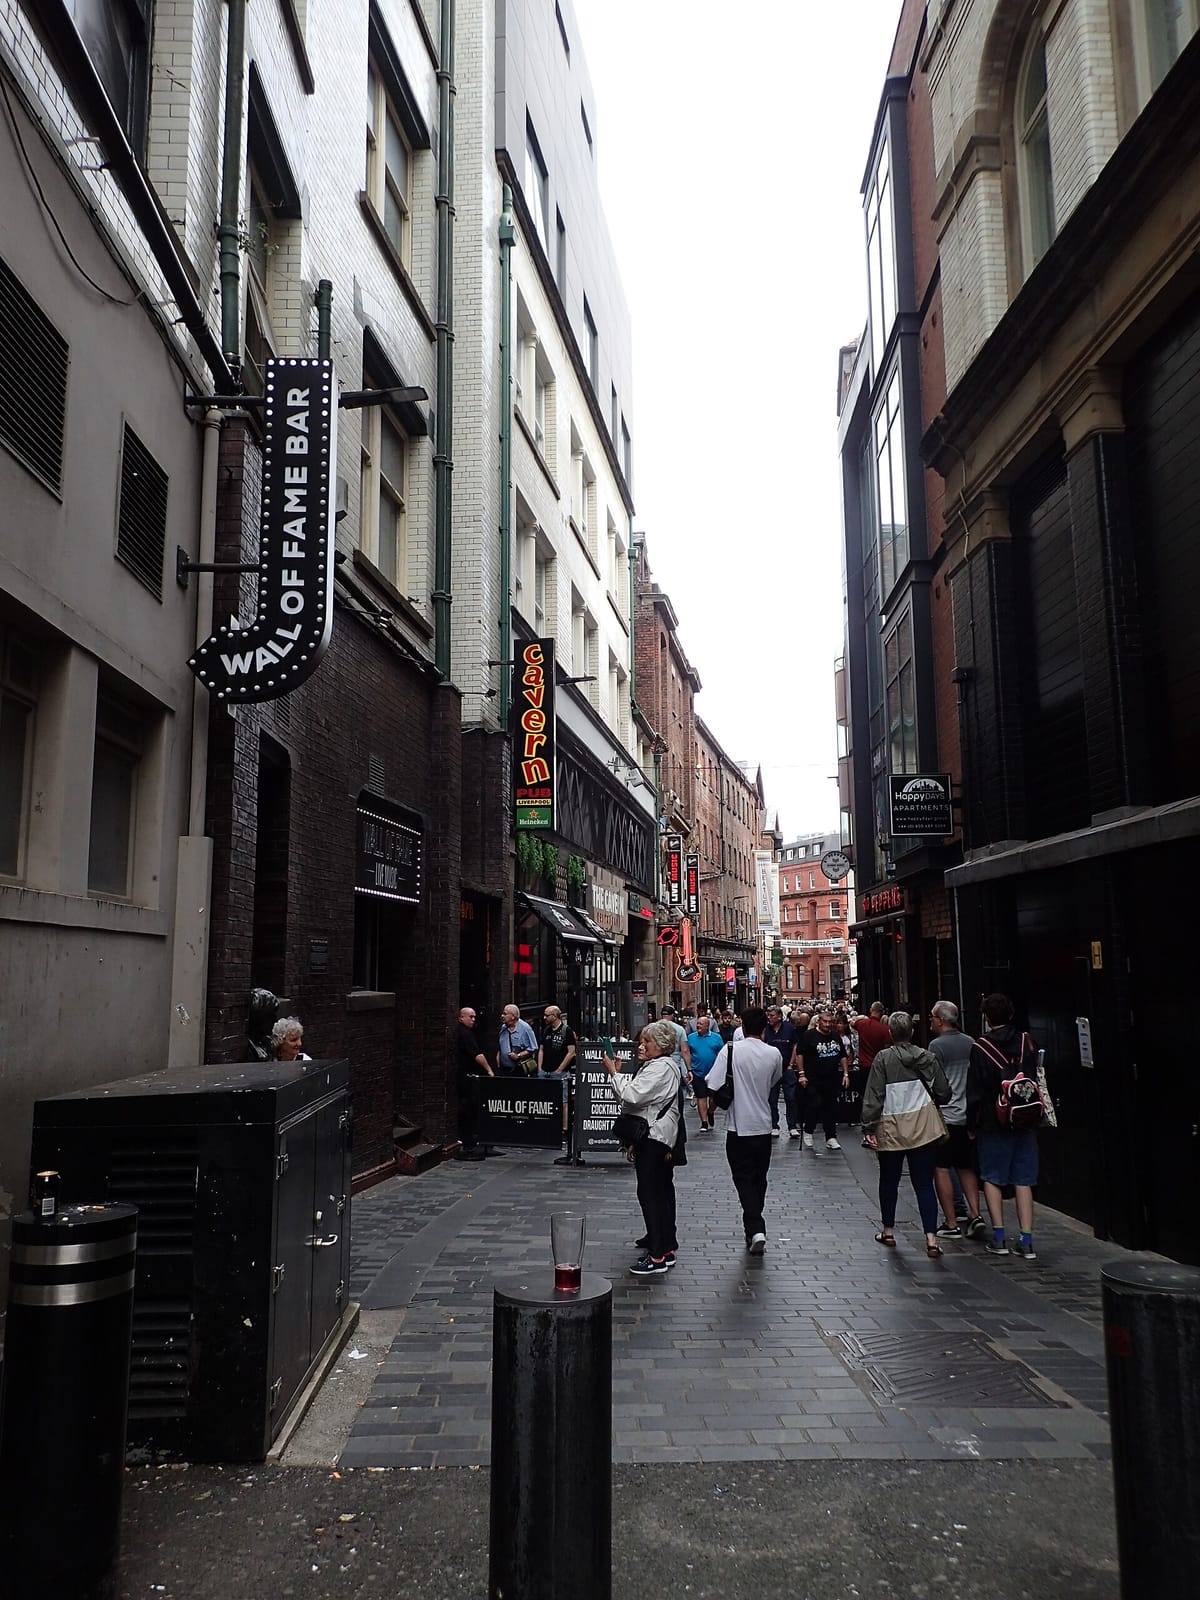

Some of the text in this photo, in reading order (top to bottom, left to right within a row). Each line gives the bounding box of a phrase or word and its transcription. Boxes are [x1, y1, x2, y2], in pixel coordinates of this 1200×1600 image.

[220, 387, 311, 676] WALL OF FAME BAR
[521, 643, 551, 785] cavern
[517, 787, 552, 798] PUB
[592, 884, 604, 910] THE
[671, 882, 679, 902] LIVE
[584, 1050, 632, 1060] WALL AME
[581, 1073, 586, 1083] 7
[587, 1073, 605, 1083] DAYS
[591, 1088, 604, 1099] LIVE
[488, 1099, 554, 1115] WALL OF FAME
[591, 1104, 622, 1115] COCKTAILS
[583, 1119, 610, 1131] DRAUGHT
